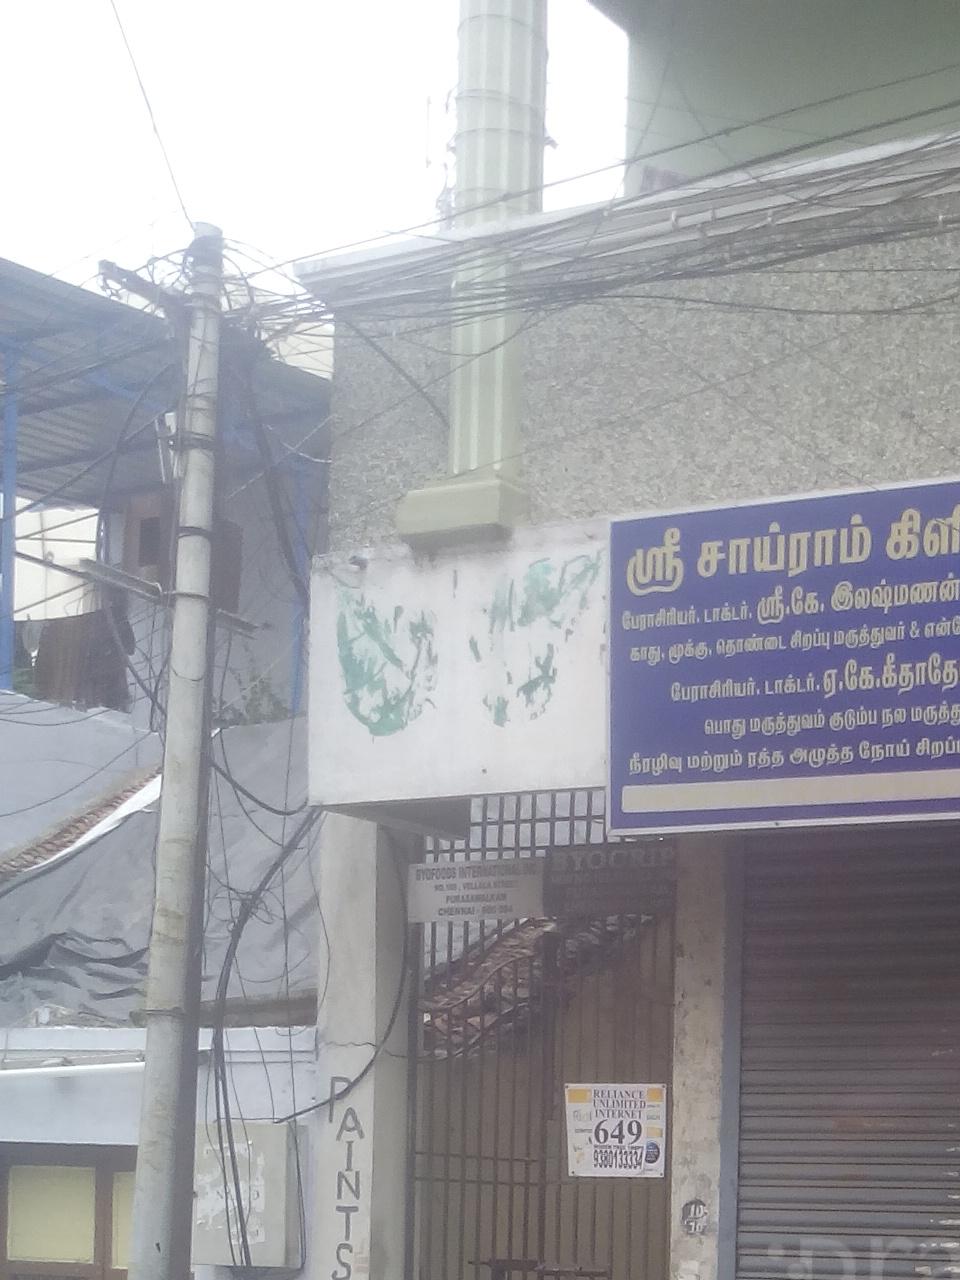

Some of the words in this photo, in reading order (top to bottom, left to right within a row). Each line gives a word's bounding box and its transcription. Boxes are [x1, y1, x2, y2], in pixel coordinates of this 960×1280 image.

[697, 514, 872, 578] சாய்ராம்
[716, 633, 786, 657] தொண்டை
[790, 628, 830, 651] சிறப்பு
[833, 621, 905, 648] மருத்துவர்
[909, 621, 921, 639] &
[704, 718, 746, 739] பொது
[749, 708, 825, 736] மருத்துவம்
[828, 706, 878, 731] குடும்ப
[882, 708, 906, 728] நல
[687, 749, 743, 772] மற்றும்
[748, 747, 784, 769] ரத்த
[859, 738, 910, 763] நோய்
[593, 1089, 643, 1099] RELIANCE
[593, 1099, 646, 1109] UNLIMITED
[595, 1109, 643, 1119] INTERNET
[594, 1119, 643, 1145] 649
